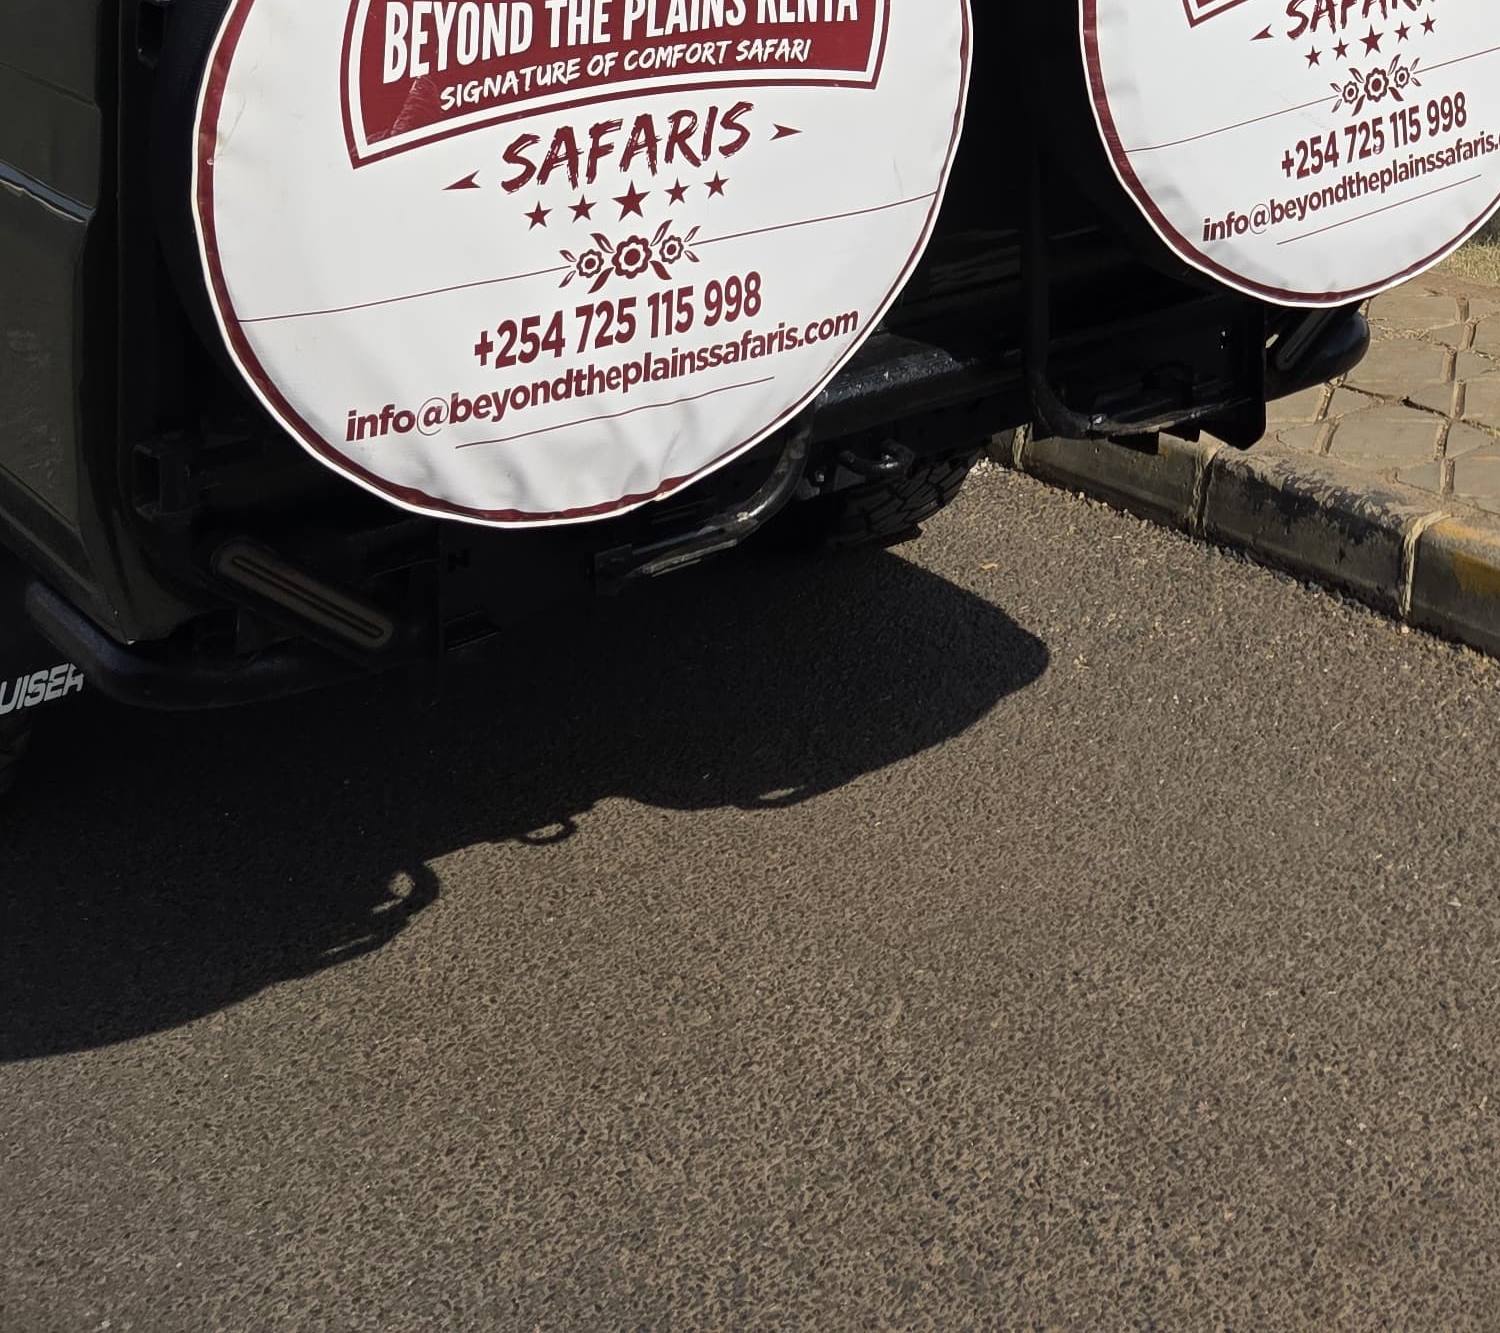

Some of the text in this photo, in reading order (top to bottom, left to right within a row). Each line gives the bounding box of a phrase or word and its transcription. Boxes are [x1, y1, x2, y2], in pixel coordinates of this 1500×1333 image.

[382, 0, 533, 84] BEYOND
[440, 38, 812, 111] SIGNATURE OF COMFORT SAFARI
[500, 101, 754, 195] SAFARIS
[1282, 92, 1467, 180] +254 725 115 998
[474, 271, 762, 370] +254 725 115 998
[345, 308, 859, 442] info@beyondtheplainssafaris.com
